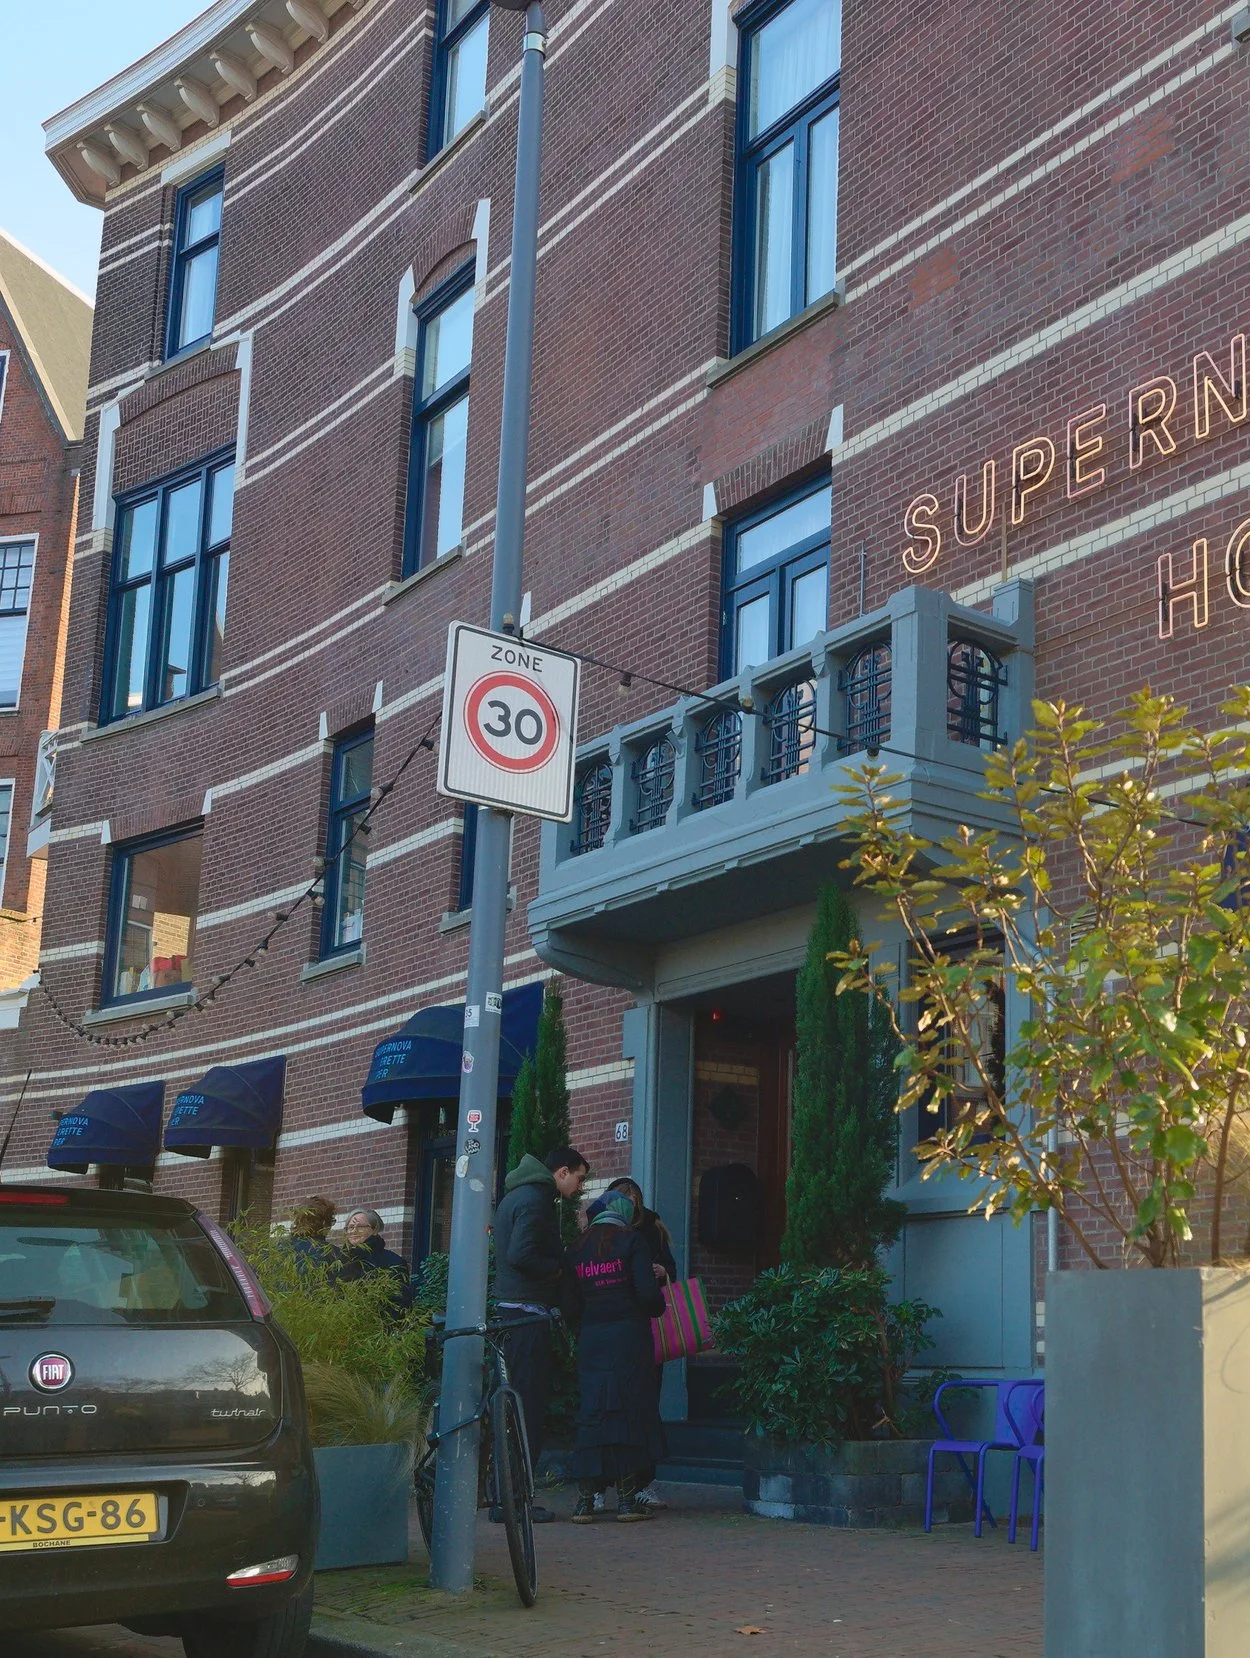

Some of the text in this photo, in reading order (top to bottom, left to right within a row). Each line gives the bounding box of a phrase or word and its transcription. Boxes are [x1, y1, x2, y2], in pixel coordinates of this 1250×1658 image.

[491, 645, 543, 673] ZONE
[483, 700, 543, 745] 30
[616, 1124, 627, 1139] 68
[42, 1364, 64, 1380] FIAT
[3, 1404, 98, 1416] PUNTO
[32, 1540, 71, 1548] BOCHANE
